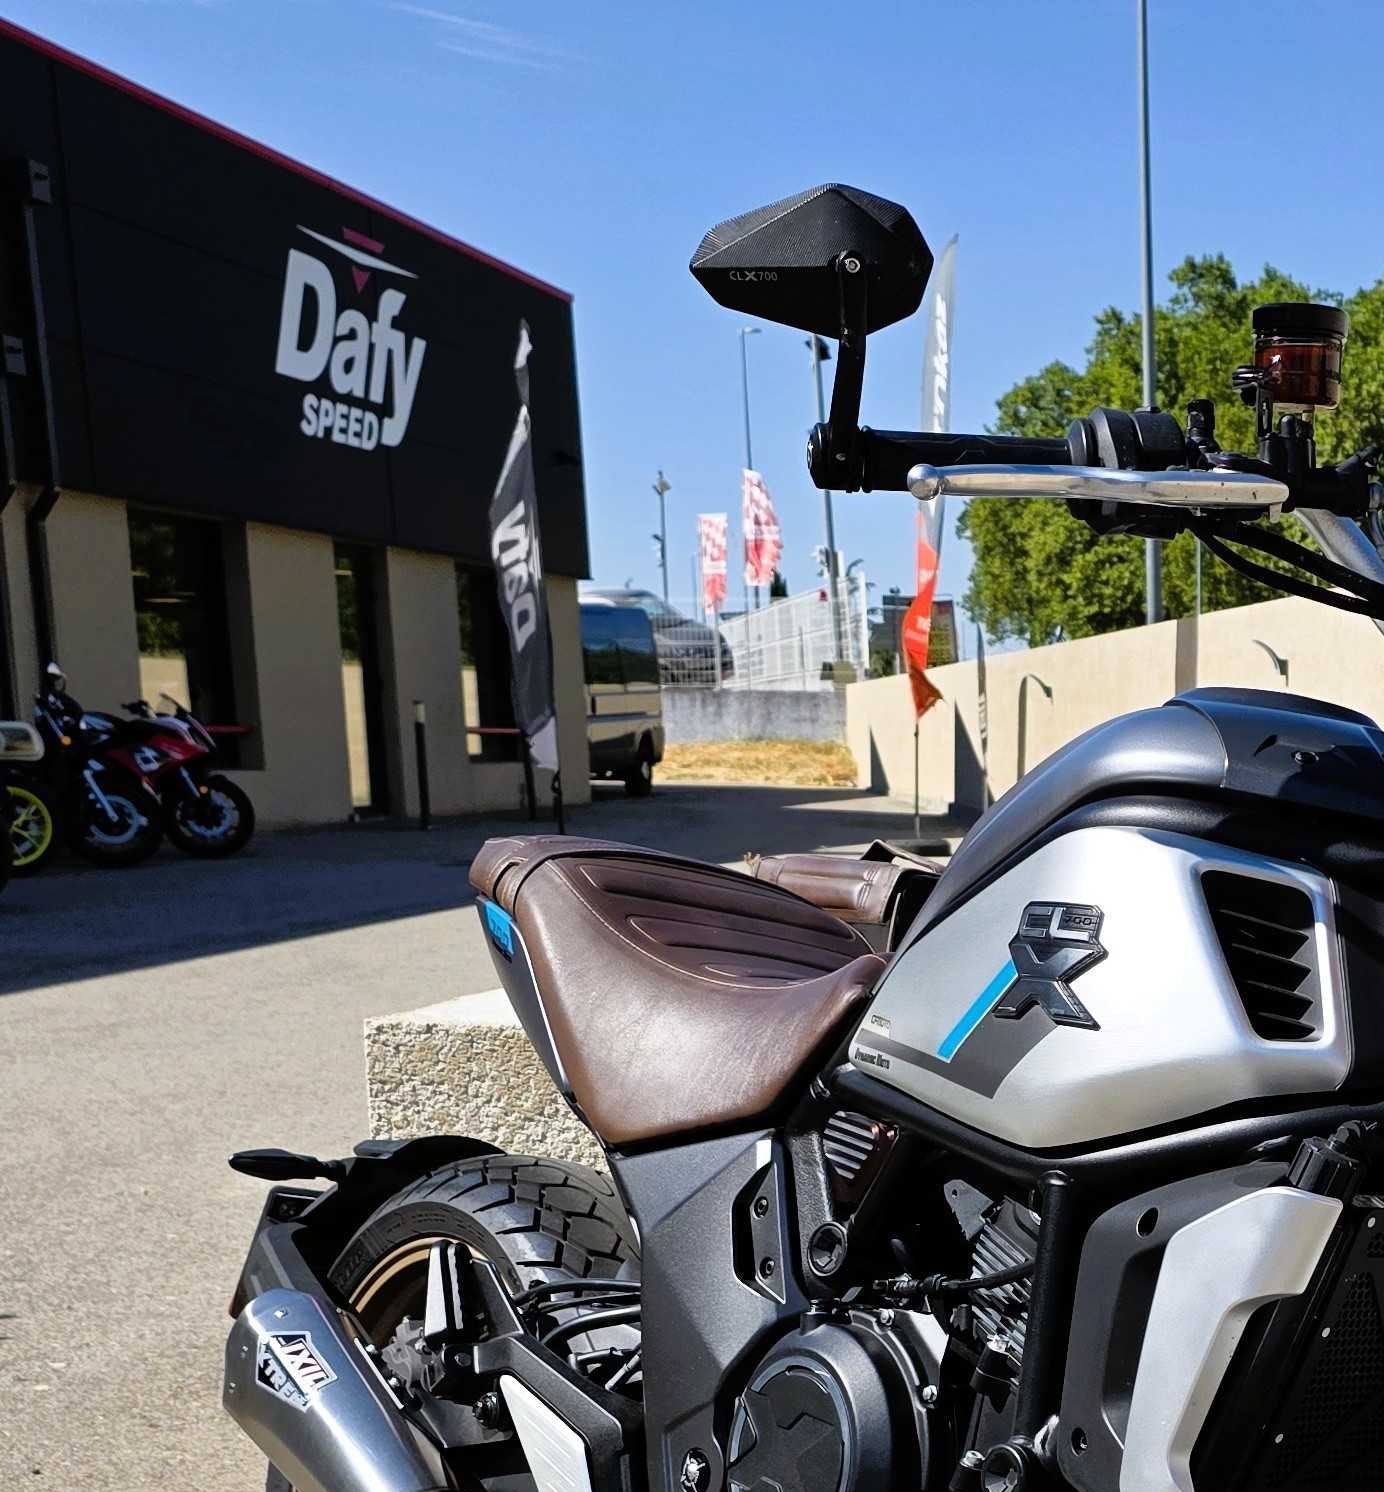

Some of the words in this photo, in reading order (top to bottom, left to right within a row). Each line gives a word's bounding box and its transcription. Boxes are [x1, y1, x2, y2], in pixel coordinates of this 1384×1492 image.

[729, 270, 778, 281] CLX700
[275, 247, 427, 447] Dafy
[301, 392, 379, 451] SPEED
